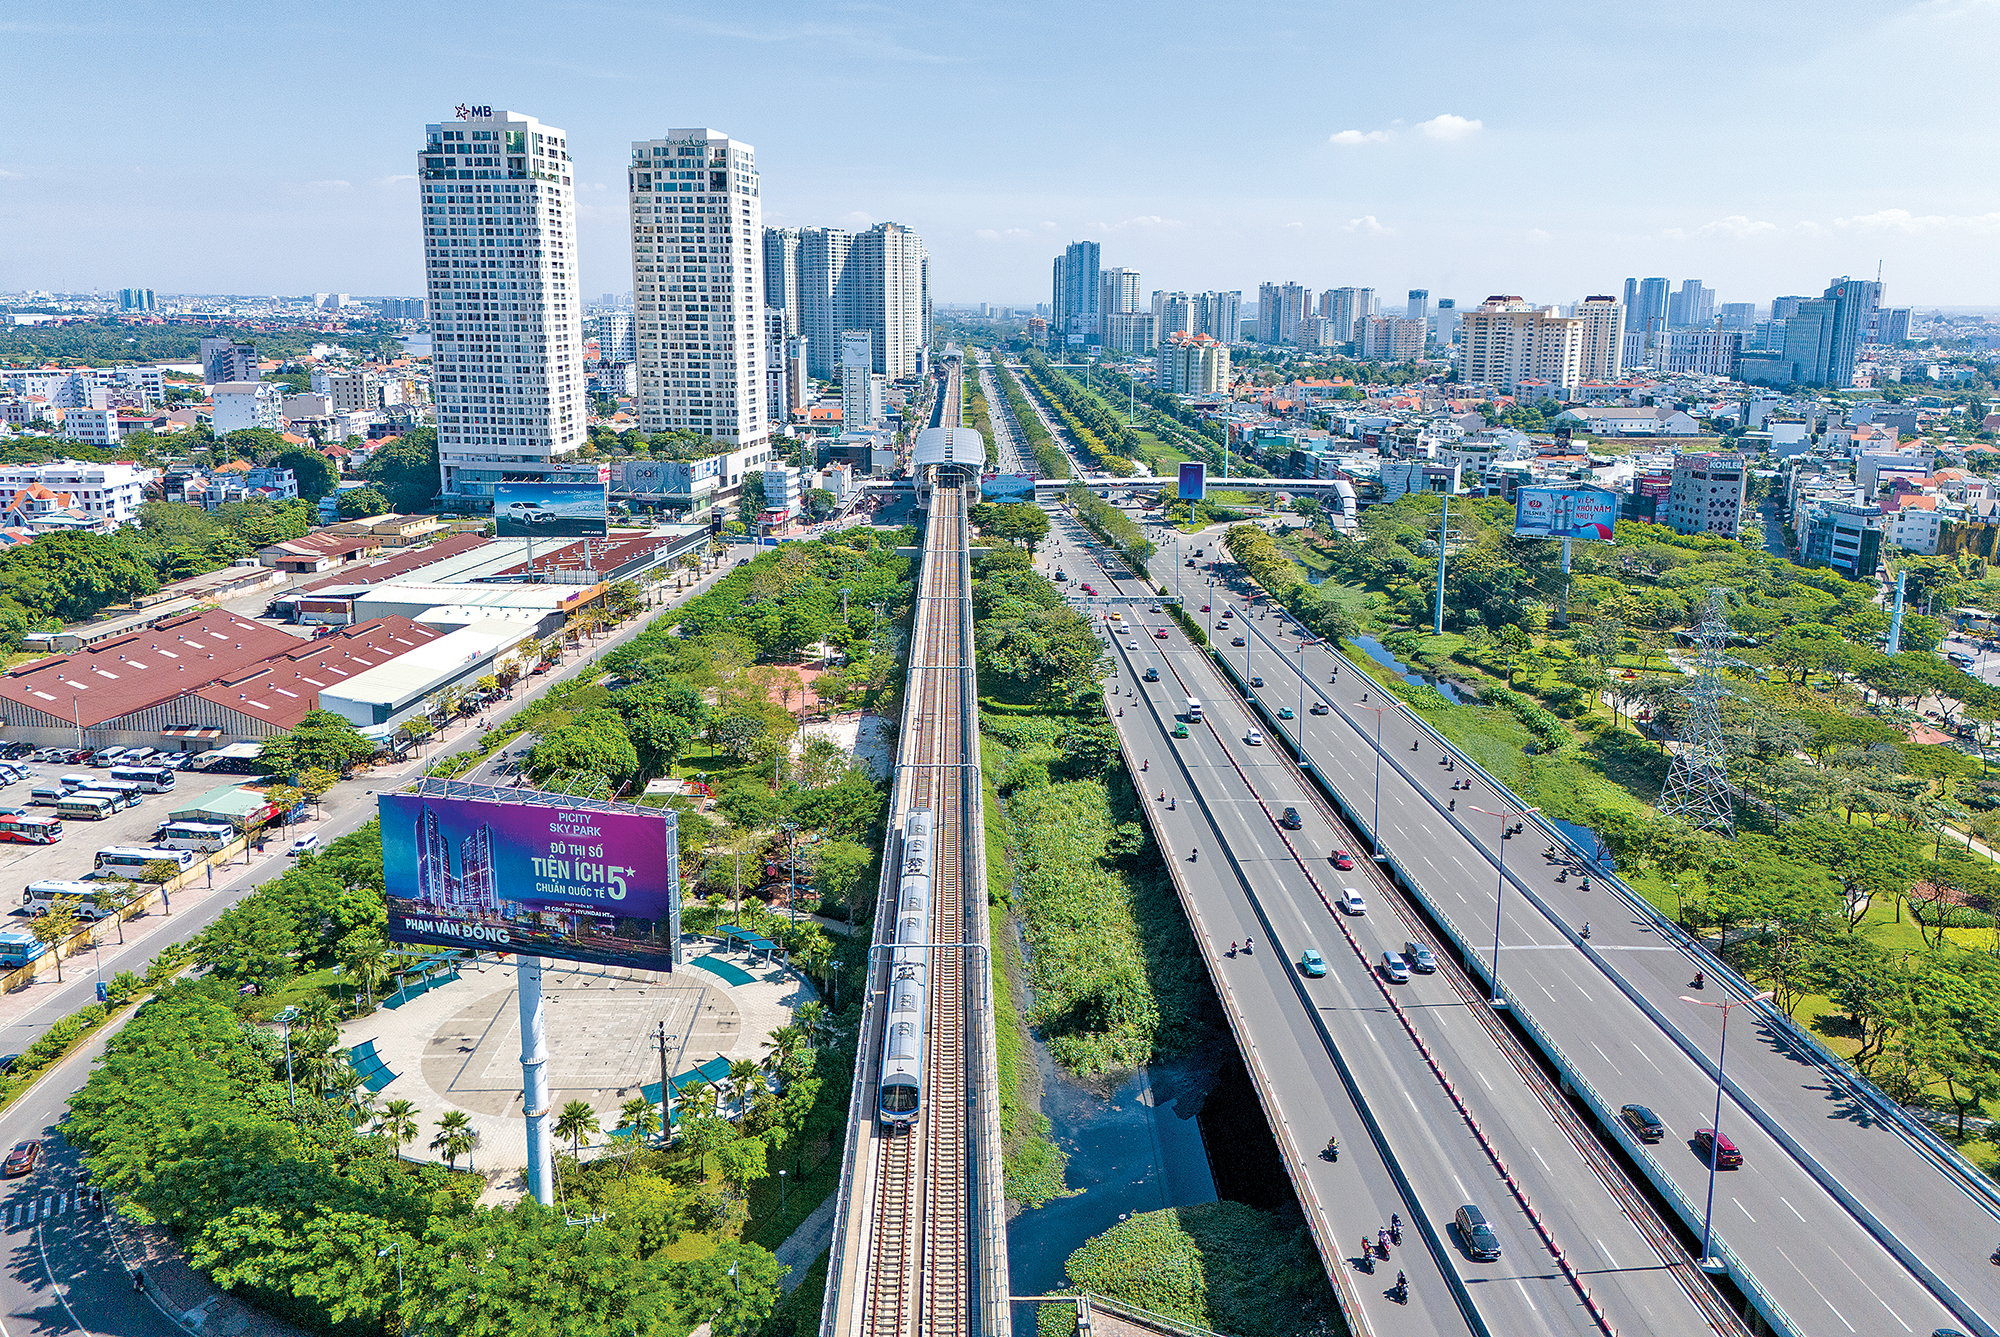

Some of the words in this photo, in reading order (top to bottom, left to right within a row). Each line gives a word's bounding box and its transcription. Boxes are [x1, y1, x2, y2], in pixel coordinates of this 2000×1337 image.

[471, 105, 492, 117] MB
[1709, 461, 1742, 469] KOHLER
[558, 812, 591, 824] PICITY
[549, 823, 570, 834] SKY
[573, 825, 601, 837] PARK
[550, 841, 566, 854] ĐÔ
[568, 844, 586, 859] THỊ
[588, 843, 603, 858] SỐ
[531, 854, 570, 882] TIỆN
[574, 857, 604, 883] ÍCH
[607, 865, 627, 900] 5
[535, 881, 566, 894] CHUẨN
[568, 884, 592, 897] QUỐC
[594, 886, 605, 898] TẾ
[575, 909, 601, 917] HYUNDAI
[405, 919, 434, 935] PHẠM
[435, 920, 460, 937] VĂN
[462, 921, 510, 944] ĐỒNG
